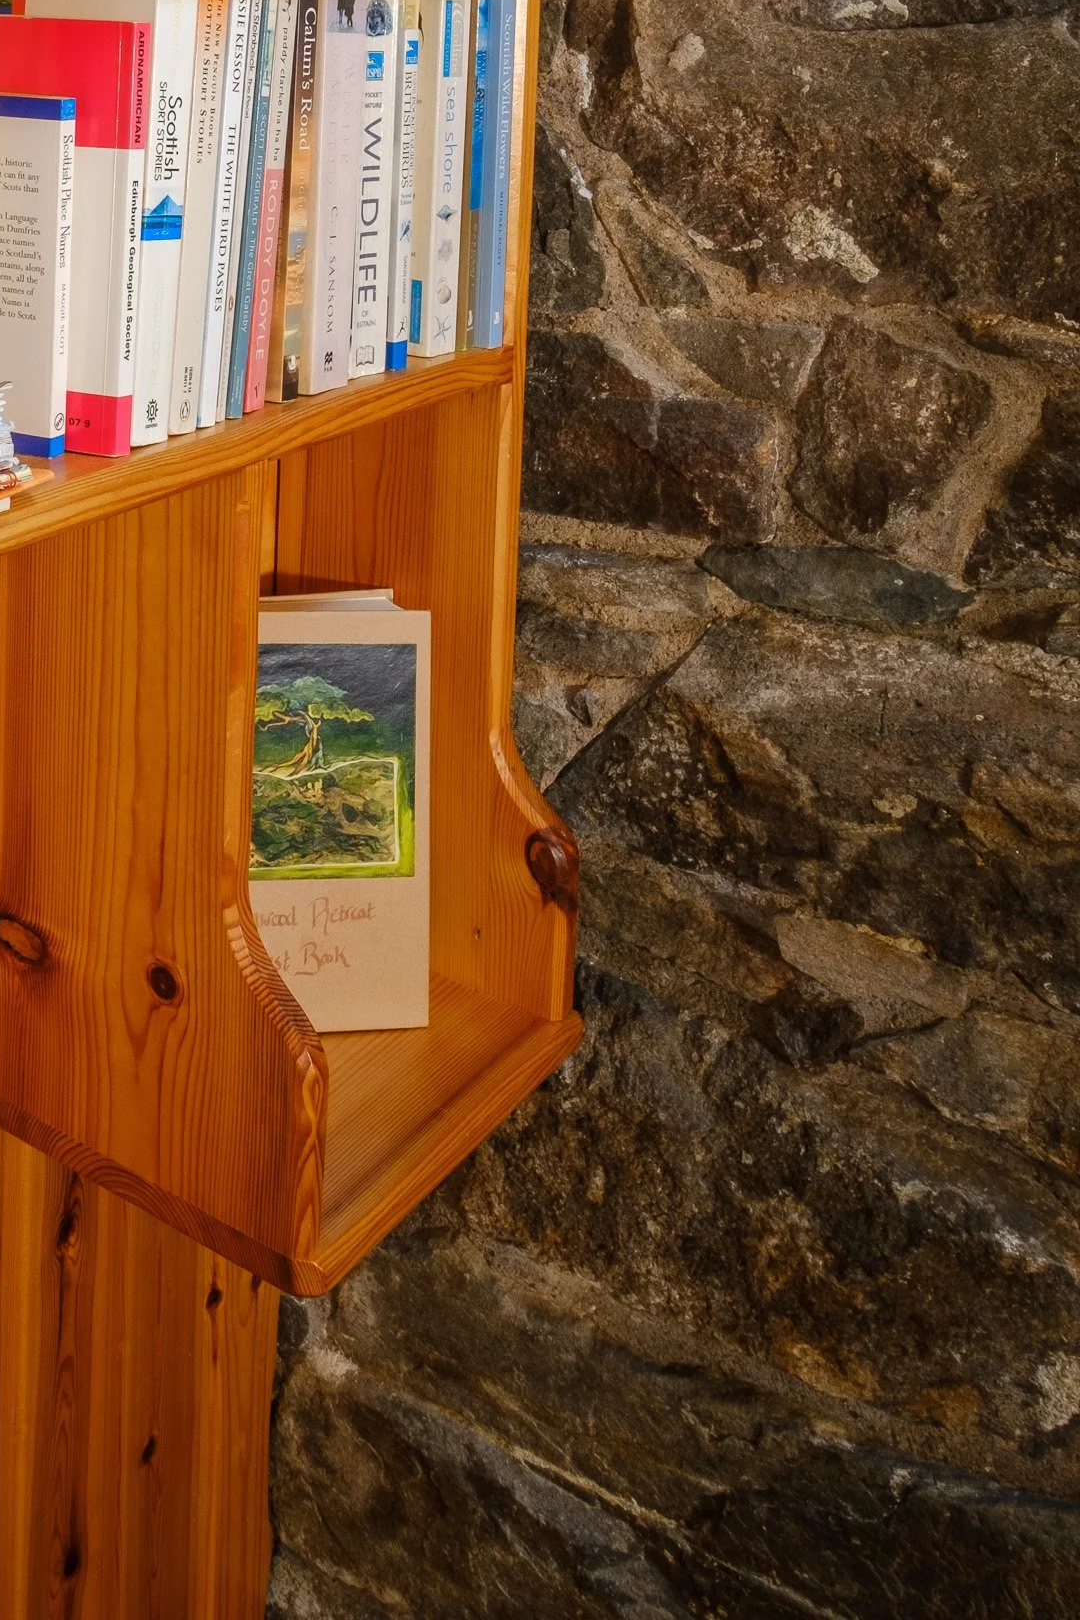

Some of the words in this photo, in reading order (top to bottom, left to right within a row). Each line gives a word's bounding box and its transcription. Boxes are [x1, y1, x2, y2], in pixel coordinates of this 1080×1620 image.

[232, 32, 245, 94] KESSON
[247, 15, 260, 72] Steinbeck
[279, 27, 289, 64] paddy
[301, 7, 317, 90] Calum's
[501, 14, 513, 71] Scottish
[134, 31, 146, 144] ARDNAMURCHAN
[200, 58, 211, 103] SHORT
[210, 53, 220, 102] PENGUIN
[276, 68, 287, 106] clarke
[501, 74, 511, 118] Wild
[157, 81, 168, 124] SHORT
[208, 106, 217, 139] BOOK
[276, 111, 284, 125] ha
[299, 98, 312, 151] Road
[403, 71, 412, 137] BRITISH
[445, 86, 456, 122] sea
[154, 128, 165, 181] STORIES
[163, 95, 184, 181] Scottish
[197, 109, 208, 165] STORIES
[227, 125, 237, 155] THE
[258, 114, 267, 151] SCOTT
[273, 148, 280, 161] ha
[274, 129, 282, 144] ha
[498, 120, 509, 179] Flowers
[5, 158, 32, 168] historic
[18, 171, 26, 180] fit
[27, 174, 40, 183] any
[62, 134, 73, 185] Scottish
[401, 141, 410, 189] BIRDS
[442, 132, 458, 194] shore
[2, 182, 22, 192] Scots
[23, 185, 39, 193] than
[60, 188, 71, 222] Place
[222, 159, 234, 214] WHITE
[251, 155, 263, 226] FITZGERALD
[5, 212, 39, 225] Language
[129, 180, 139, 242] Edinburgh
[262, 179, 279, 268] RODDY
[357, 118, 383, 305] WILDLIFE
[58, 225, 70, 269] Names
[220, 218, 229, 259] BIRD
[248, 237, 257, 258] The
[126, 246, 136, 312] Geological
[214, 263, 226, 313] PASSES
[245, 261, 255, 290] Great
[325, 255, 337, 334] SANSOM
[241, 292, 253, 333] Gatsby
[255, 279, 270, 360] DOYLE
[357, 319, 376, 328] BRITAIN
[123, 315, 133, 362] Society
[308, 896, 377, 936] Retreat
[294, 941, 352, 976] Book
